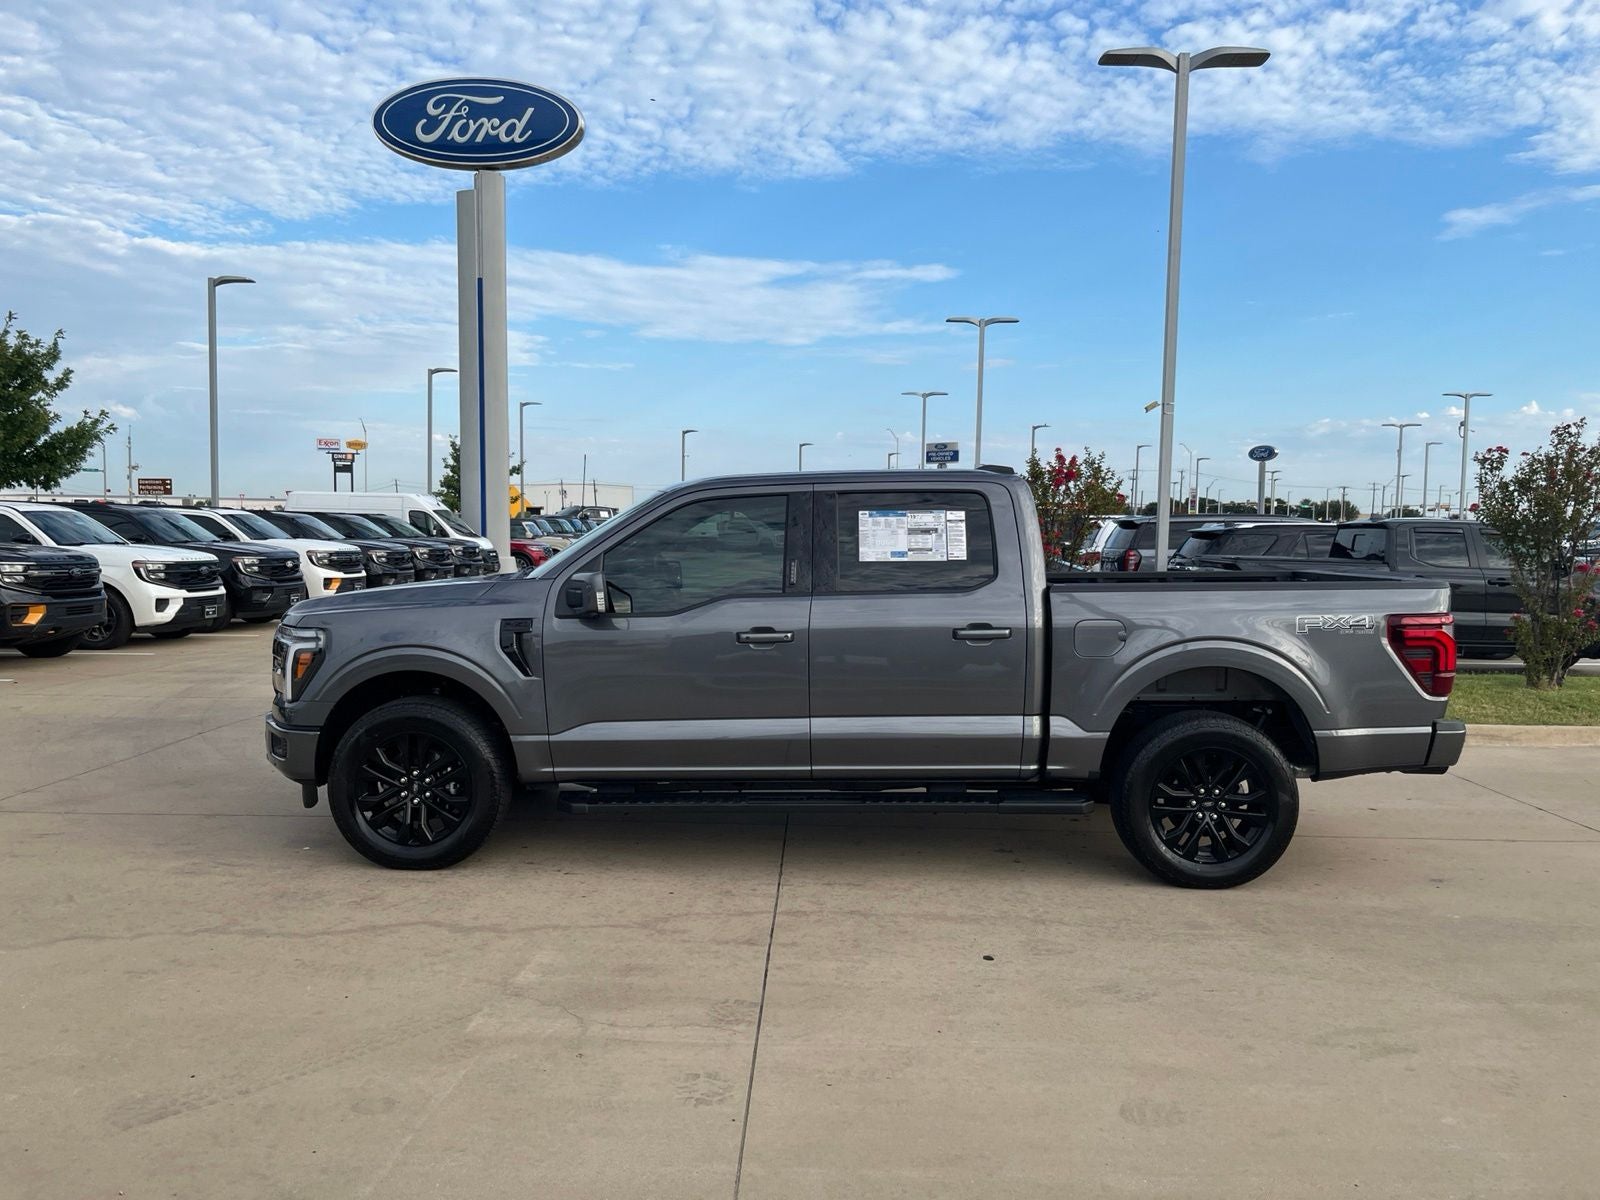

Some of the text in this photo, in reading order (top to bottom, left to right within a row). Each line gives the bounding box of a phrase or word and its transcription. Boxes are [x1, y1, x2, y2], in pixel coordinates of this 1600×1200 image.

[415, 93, 535, 143] Ford
[318, 439, 339, 448] Exxon
[1252, 448, 1269, 458] Ford
[1296, 614, 1375, 634] FX4
